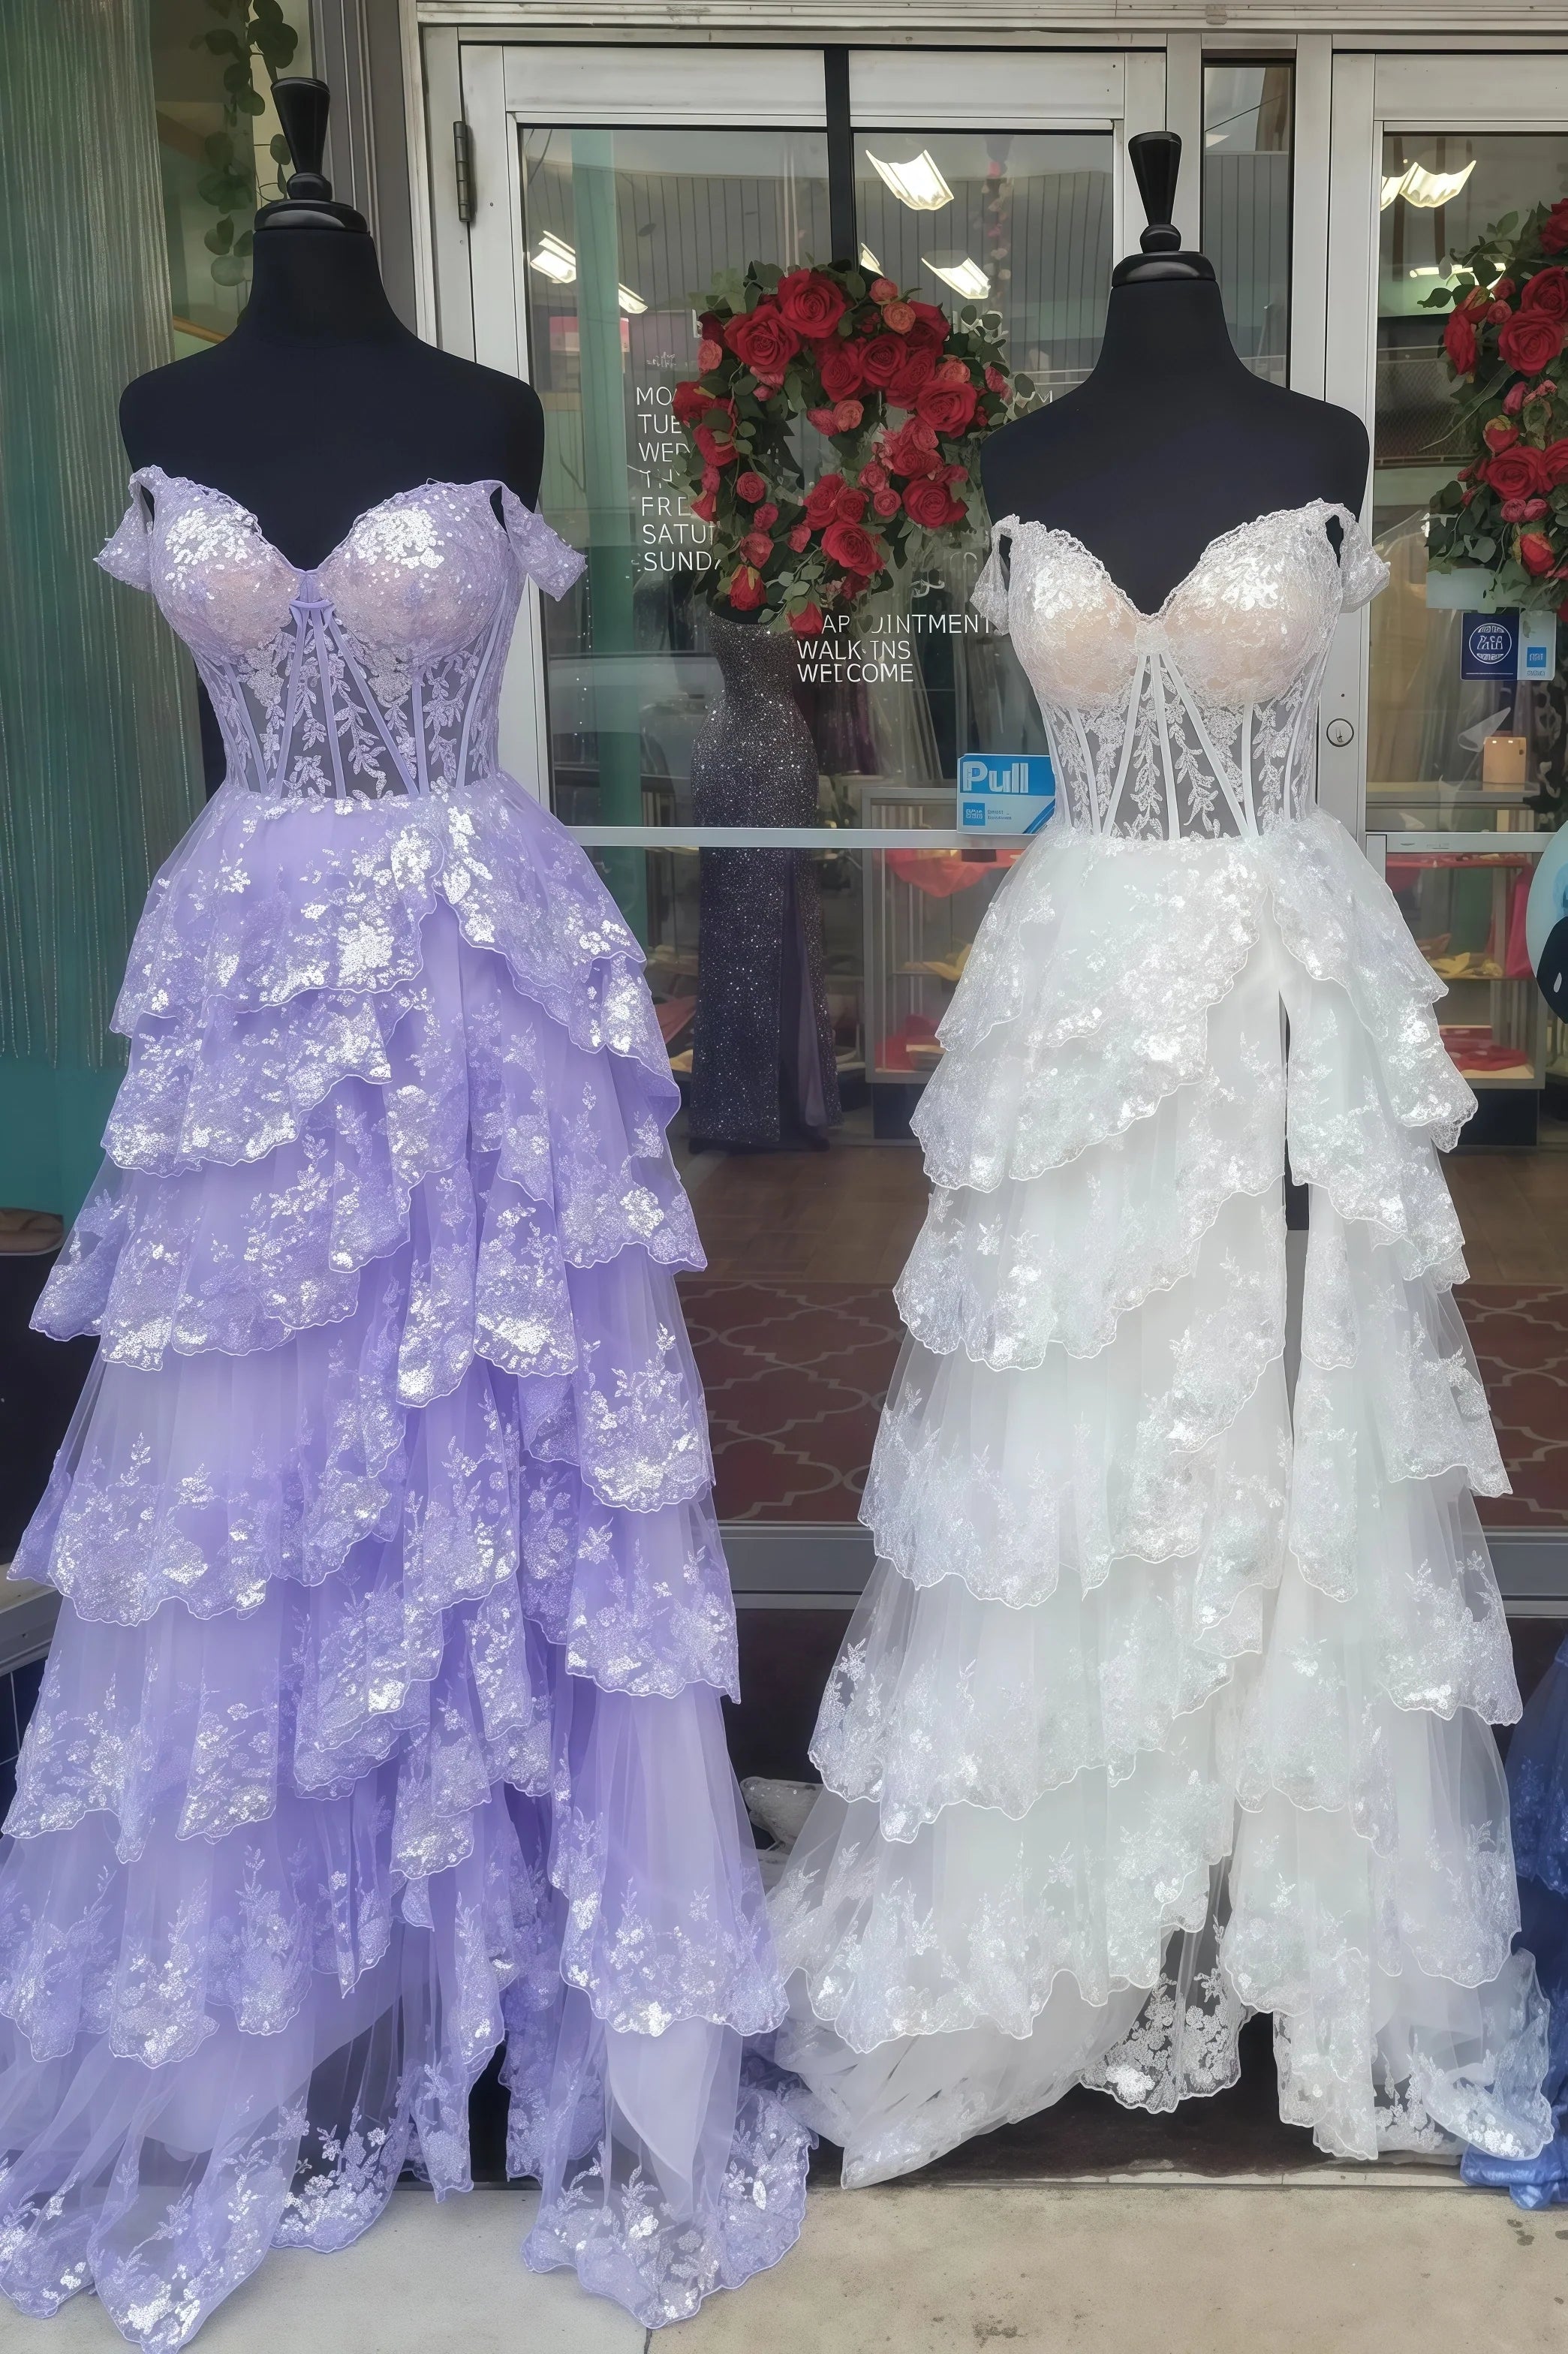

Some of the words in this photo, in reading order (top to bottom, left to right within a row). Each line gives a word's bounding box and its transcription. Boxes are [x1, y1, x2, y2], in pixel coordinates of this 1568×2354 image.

[637, 386, 677, 405] MO
[821, 614, 990, 634] APINTMENT
[796, 663, 914, 683] WELCOME
[962, 760, 1029, 793] Pull
